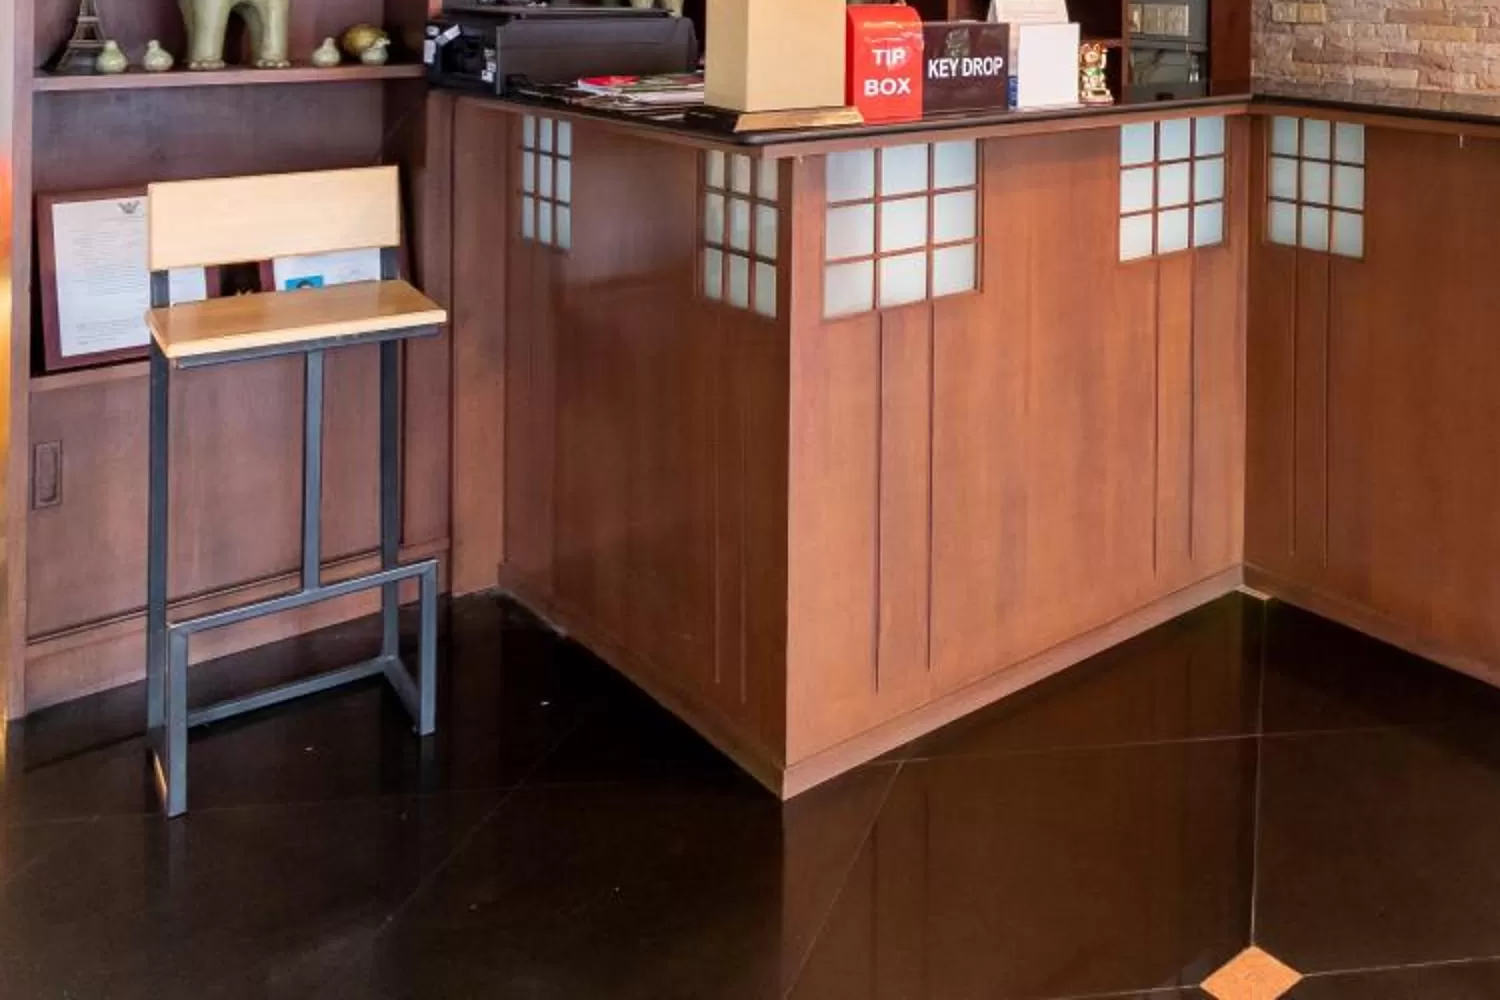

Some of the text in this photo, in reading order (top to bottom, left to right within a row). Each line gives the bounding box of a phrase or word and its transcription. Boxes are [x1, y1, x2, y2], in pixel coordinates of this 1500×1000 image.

[872, 48, 907, 67] TIP
[927, 56, 1003, 78] KEY DROP
[864, 77, 911, 96] BOX
